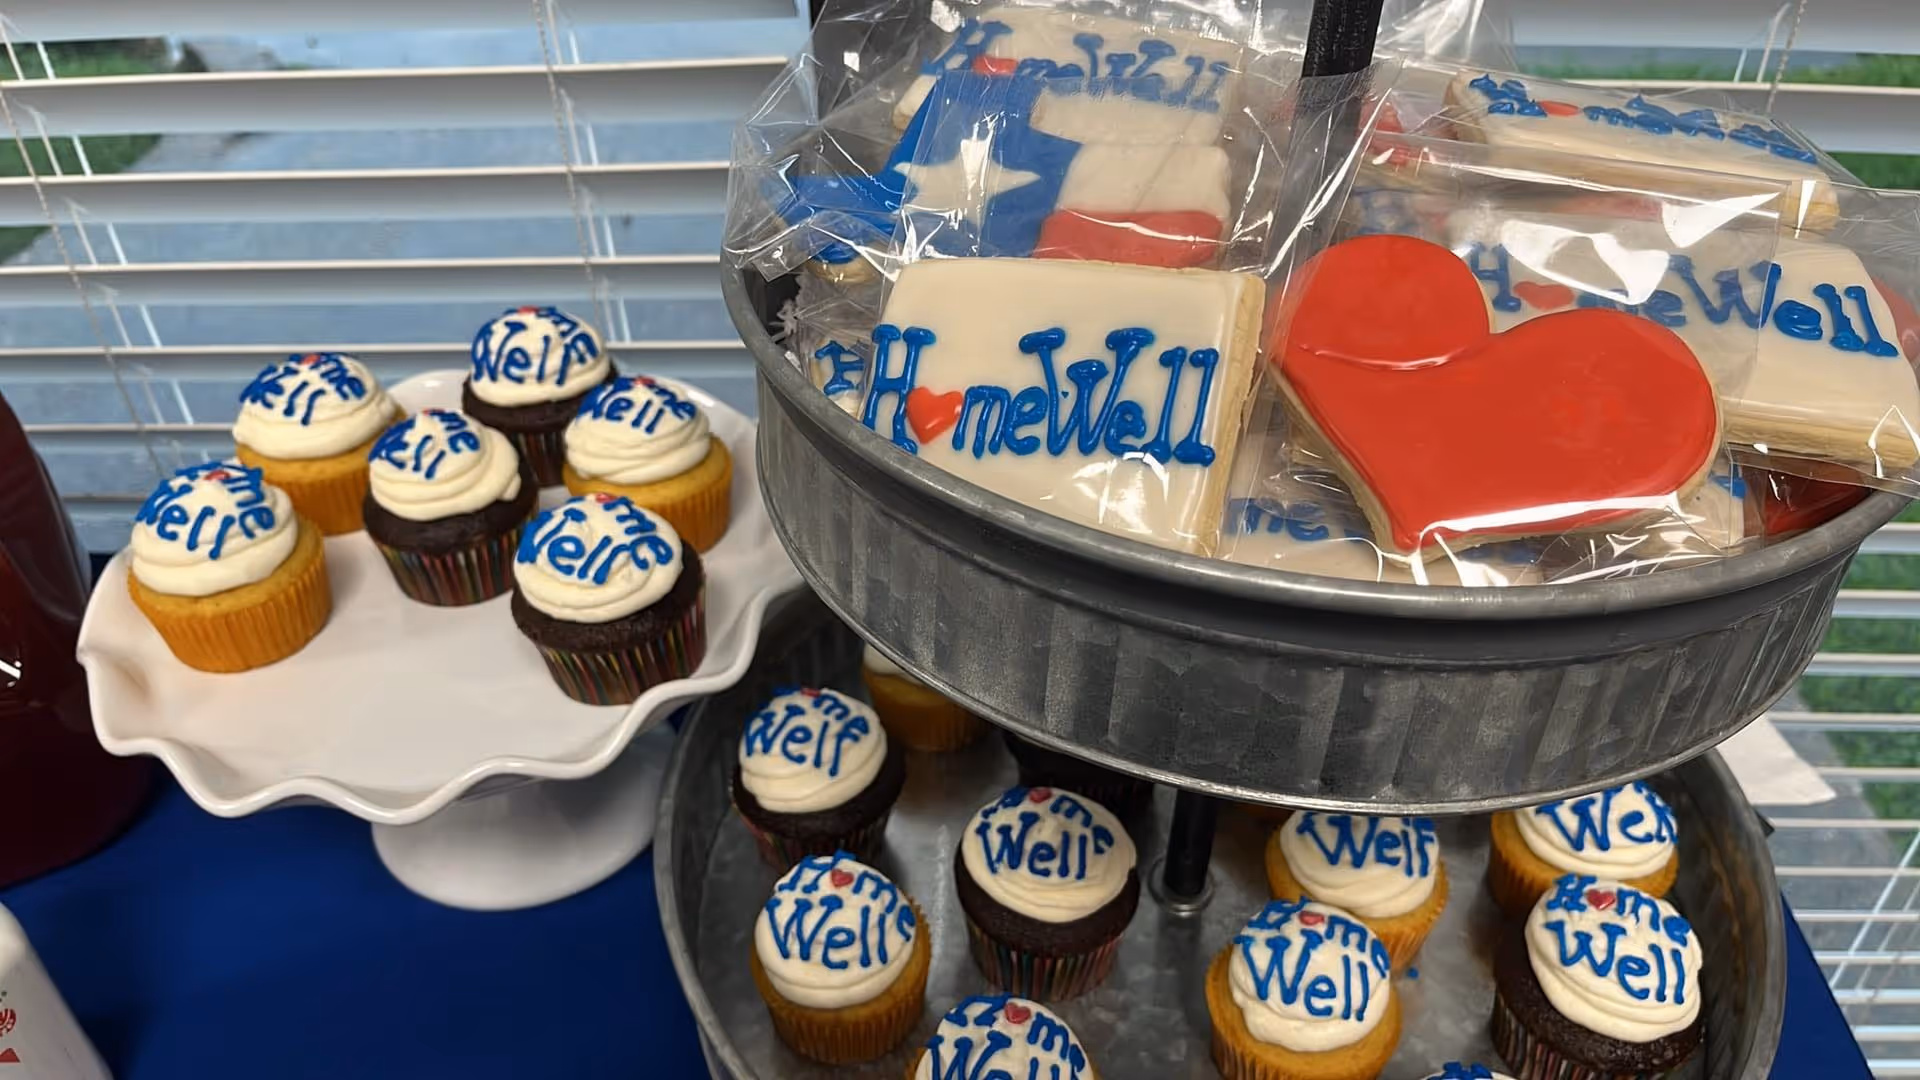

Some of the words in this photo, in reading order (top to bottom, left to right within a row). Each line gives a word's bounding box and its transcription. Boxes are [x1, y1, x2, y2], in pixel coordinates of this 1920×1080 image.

[975, 811, 1087, 880] Well
[764, 894, 889, 970] Well
[1542, 920, 1686, 1005] Well
[1232, 928, 1370, 1022] Well
